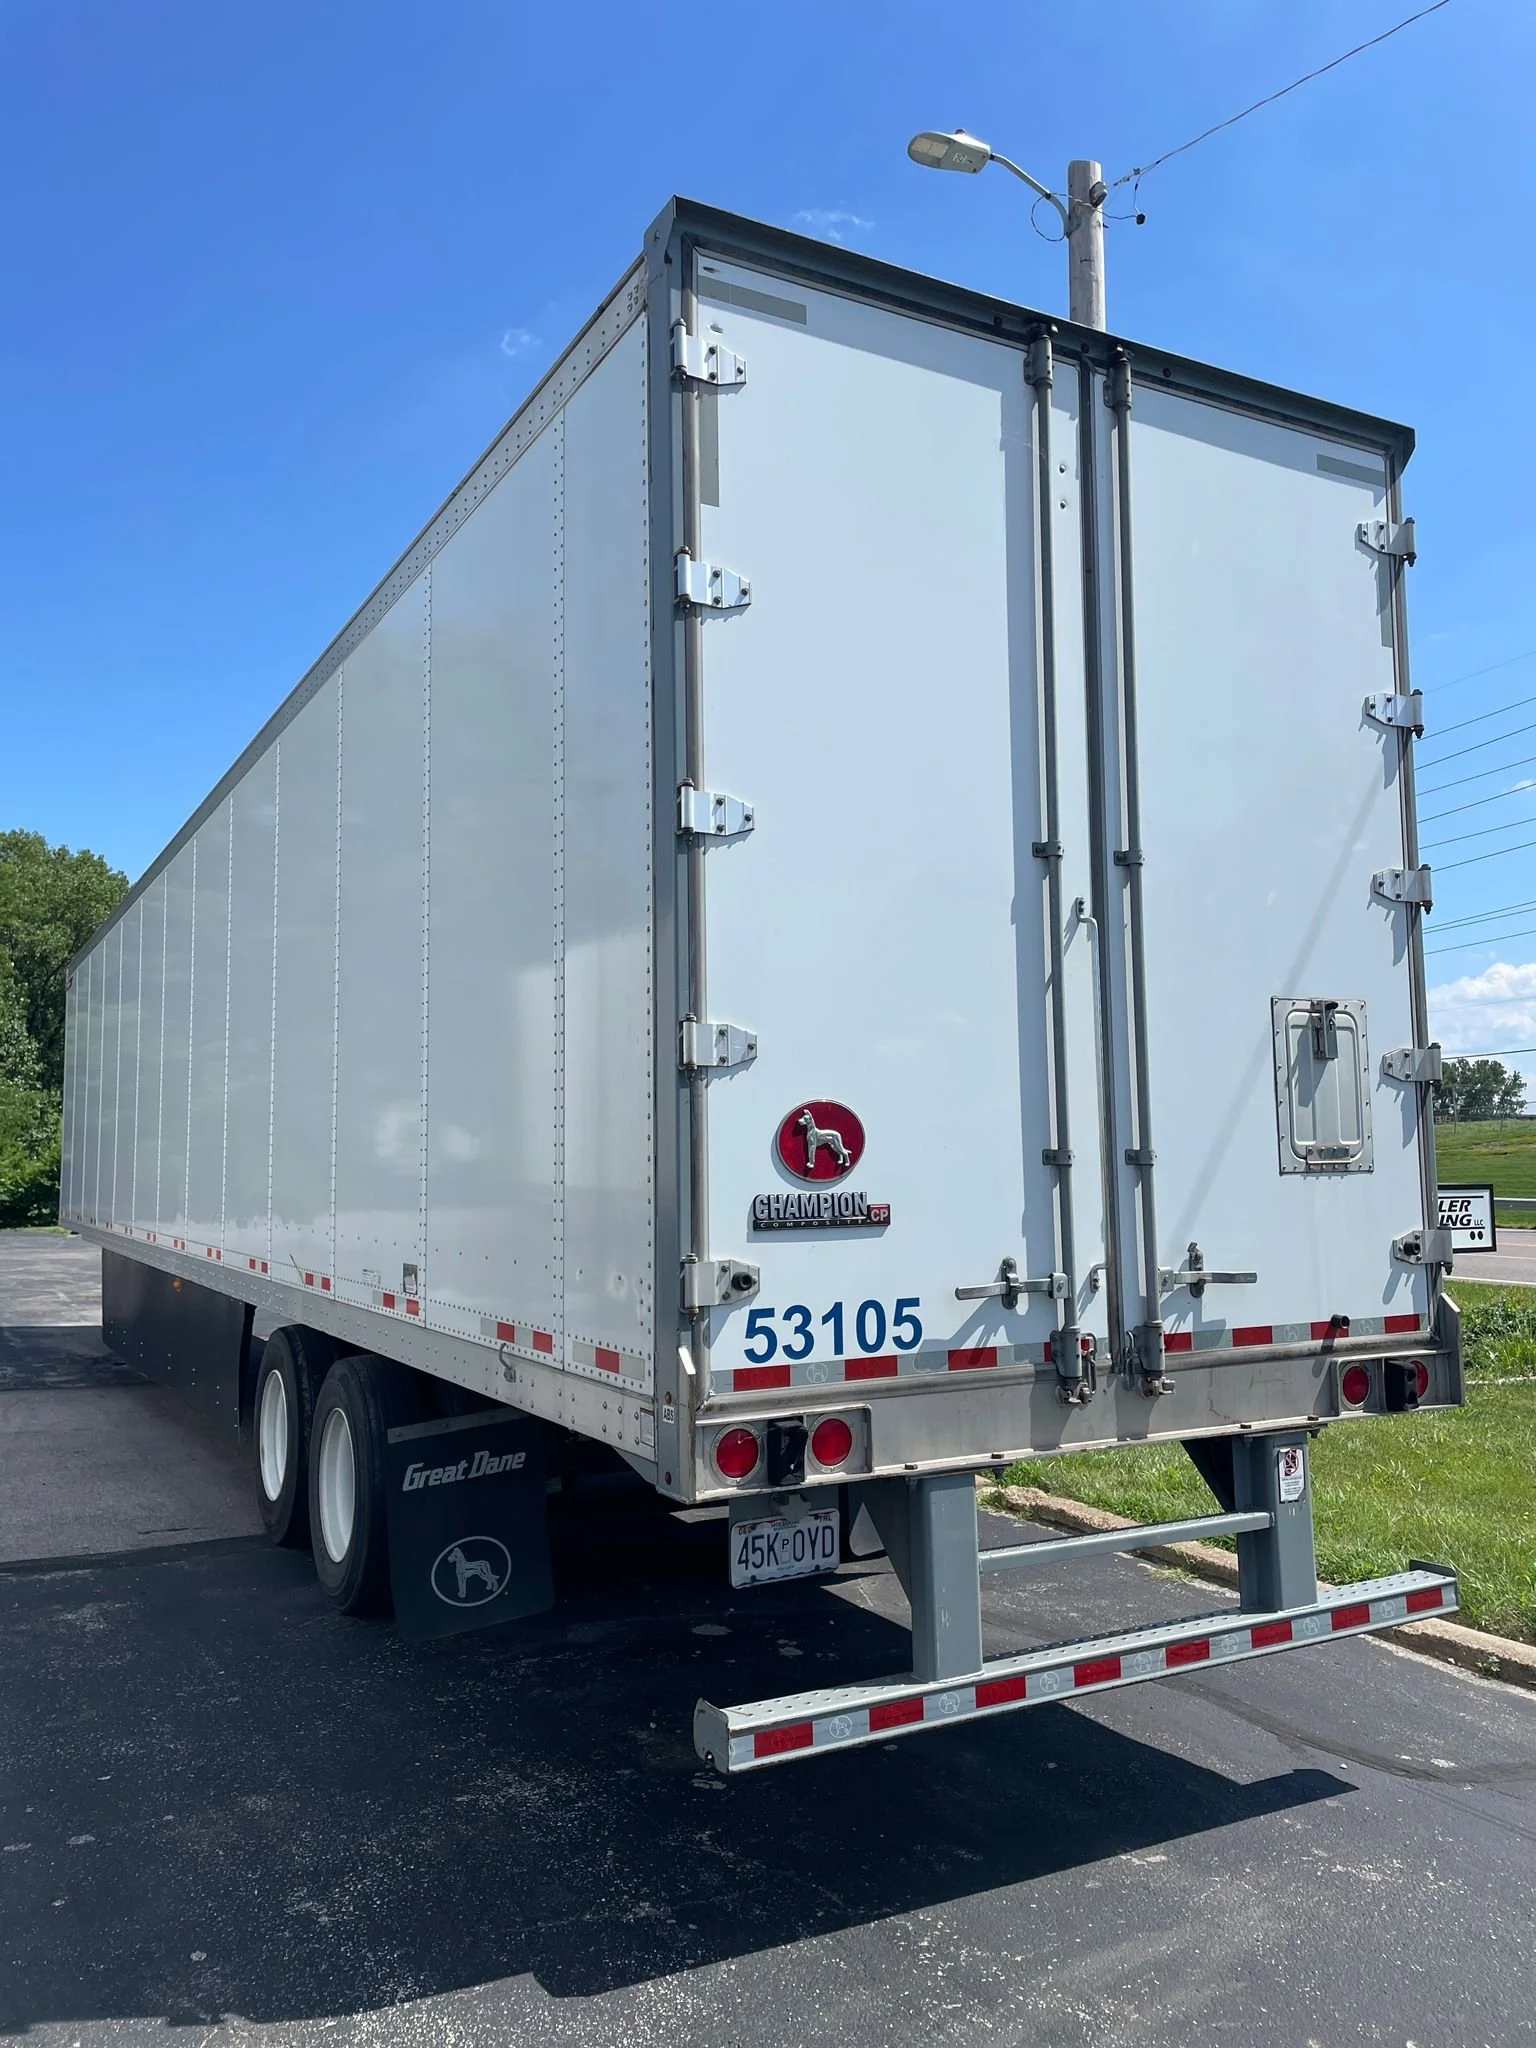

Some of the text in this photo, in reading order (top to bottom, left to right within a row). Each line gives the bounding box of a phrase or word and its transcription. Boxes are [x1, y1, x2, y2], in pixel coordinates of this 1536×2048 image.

[754, 1192, 867, 1220] CHAMPION
[870, 1208, 888, 1222] CP
[760, 1219, 863, 1228] COMPOSITE
[744, 1297, 923, 1364] 53105
[663, 1407, 674, 1422] ABS
[402, 1450, 526, 1492] Great Dane
[737, 1532, 779, 1571] 45K
